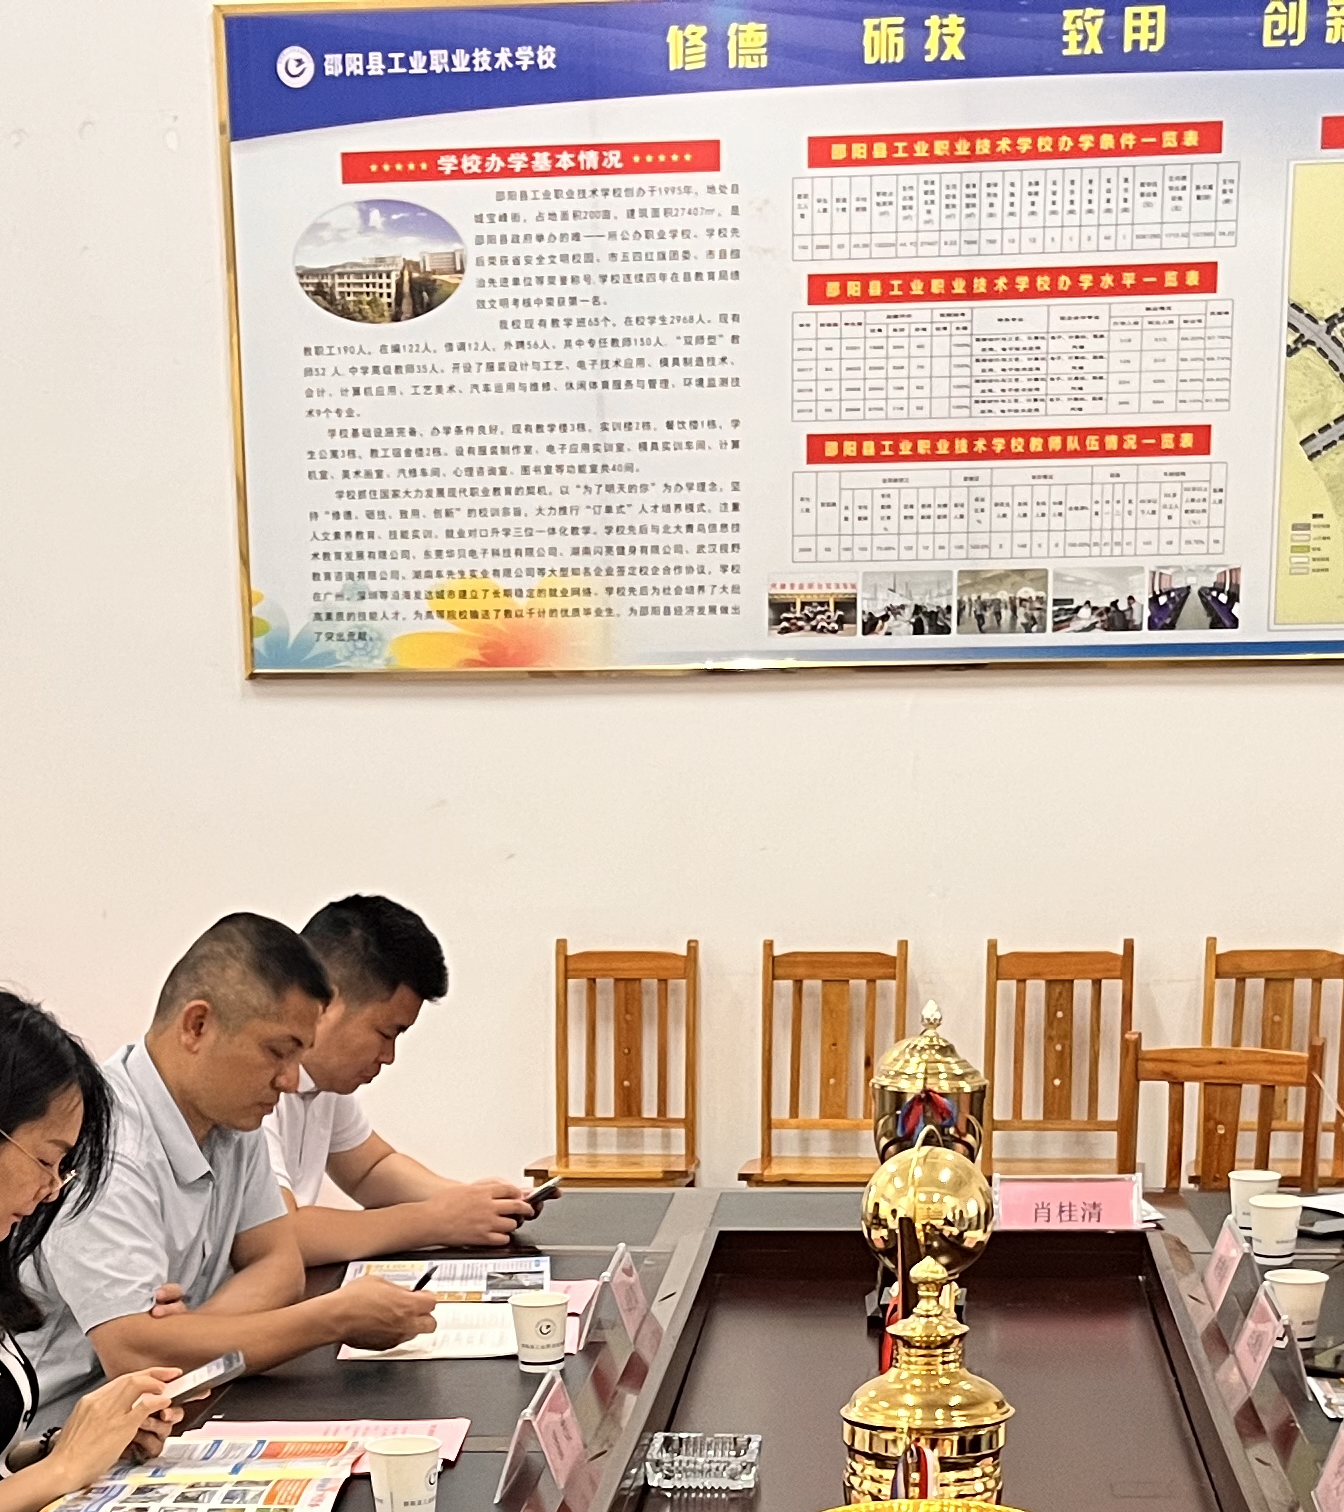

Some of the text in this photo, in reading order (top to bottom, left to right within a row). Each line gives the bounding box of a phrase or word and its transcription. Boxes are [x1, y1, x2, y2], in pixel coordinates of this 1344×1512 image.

[666, 21, 769, 71] 修德
[863, 13, 965, 64] 砺技
[1062, 5, 1167, 57] 致用
[323, 44, 557, 77] 邵阳县工业职业技术学校
[831, 129, 1202, 161] 邵阳县工业职业技术学校办学条件一览表
[437, 150, 624, 176] 学校办学基本情况
[825, 270, 1200, 299] 邵阳县工业职业技术学校办学水平一览表
[824, 432, 1195, 458] 邵阳县工业职业技术学校教师队伍情况一览表
[1034, 1201, 1103, 1223] 肖桂清
